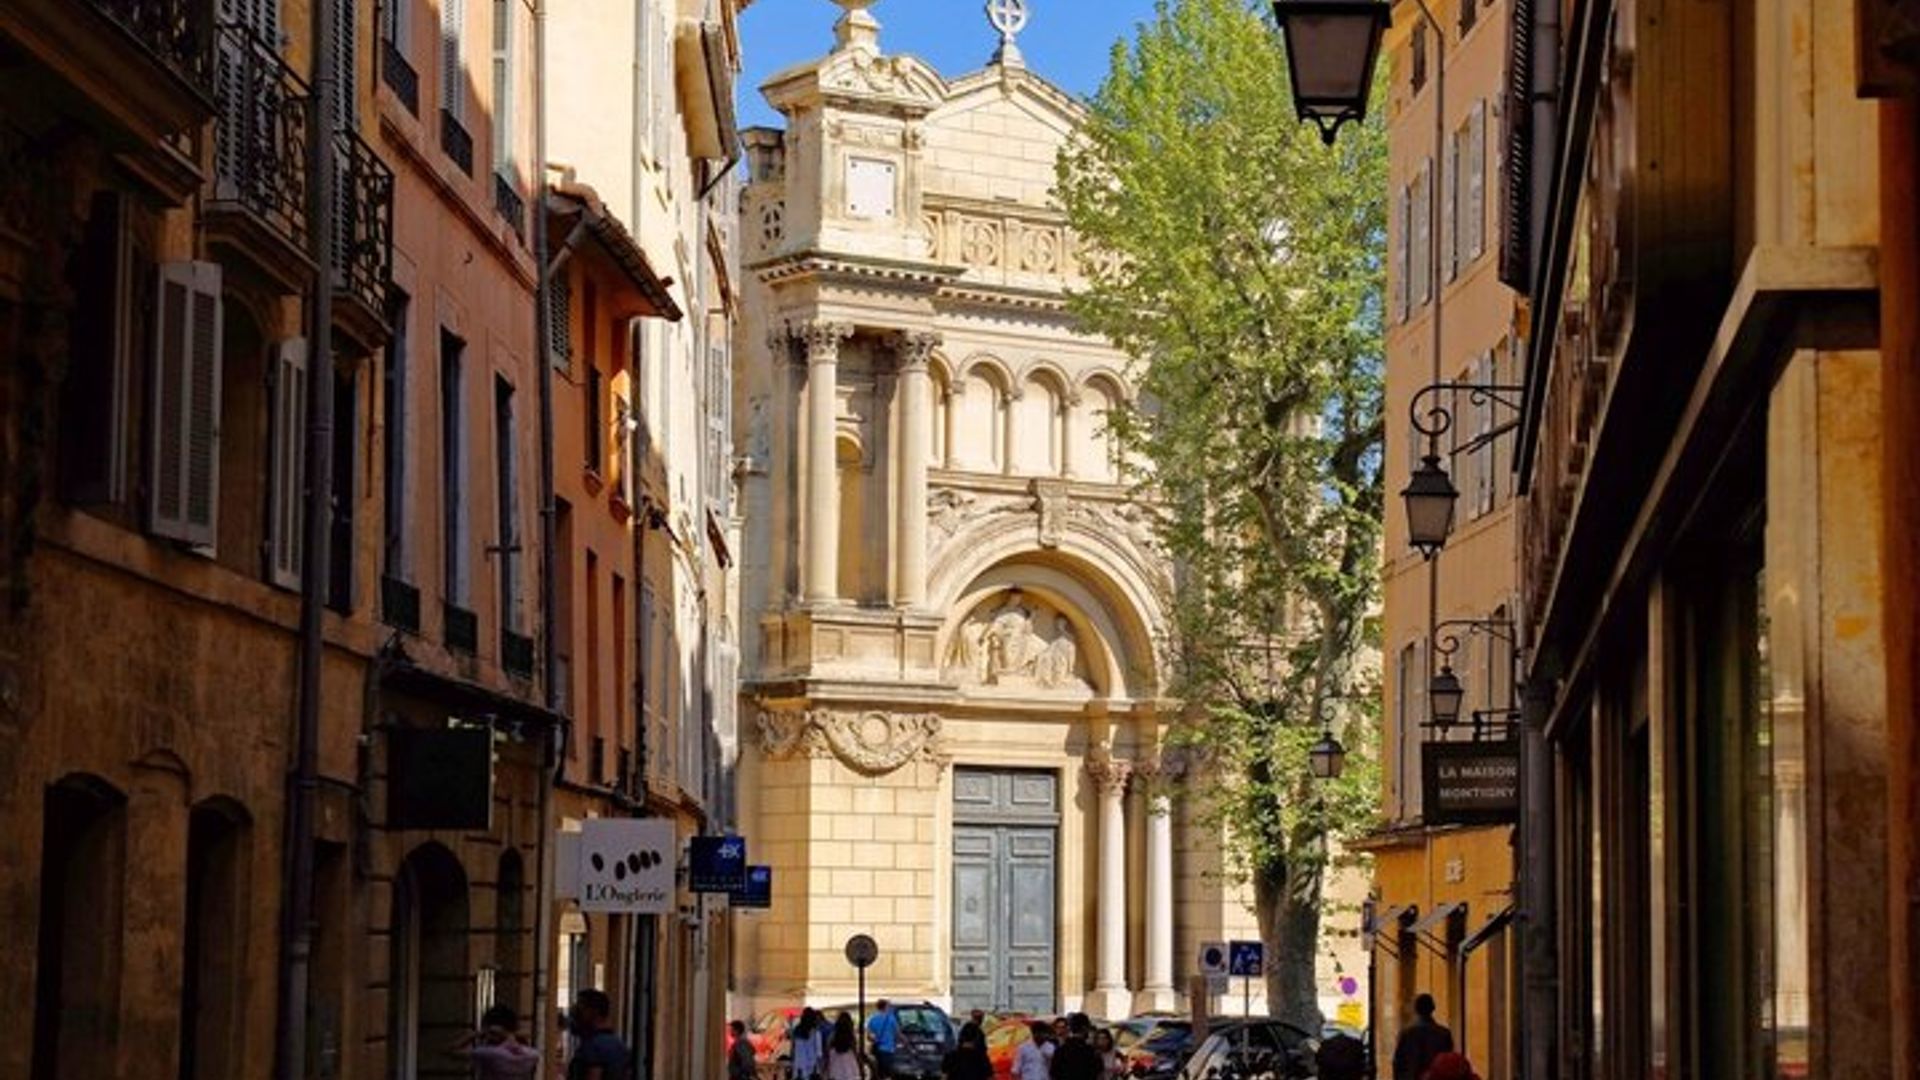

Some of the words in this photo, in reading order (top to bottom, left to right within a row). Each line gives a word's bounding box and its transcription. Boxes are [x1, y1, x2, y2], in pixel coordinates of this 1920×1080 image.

[1439, 766, 1457, 779] LA
[1461, 766, 1516, 778] MAISON
[1439, 787, 1516, 799] MONTIGNY
